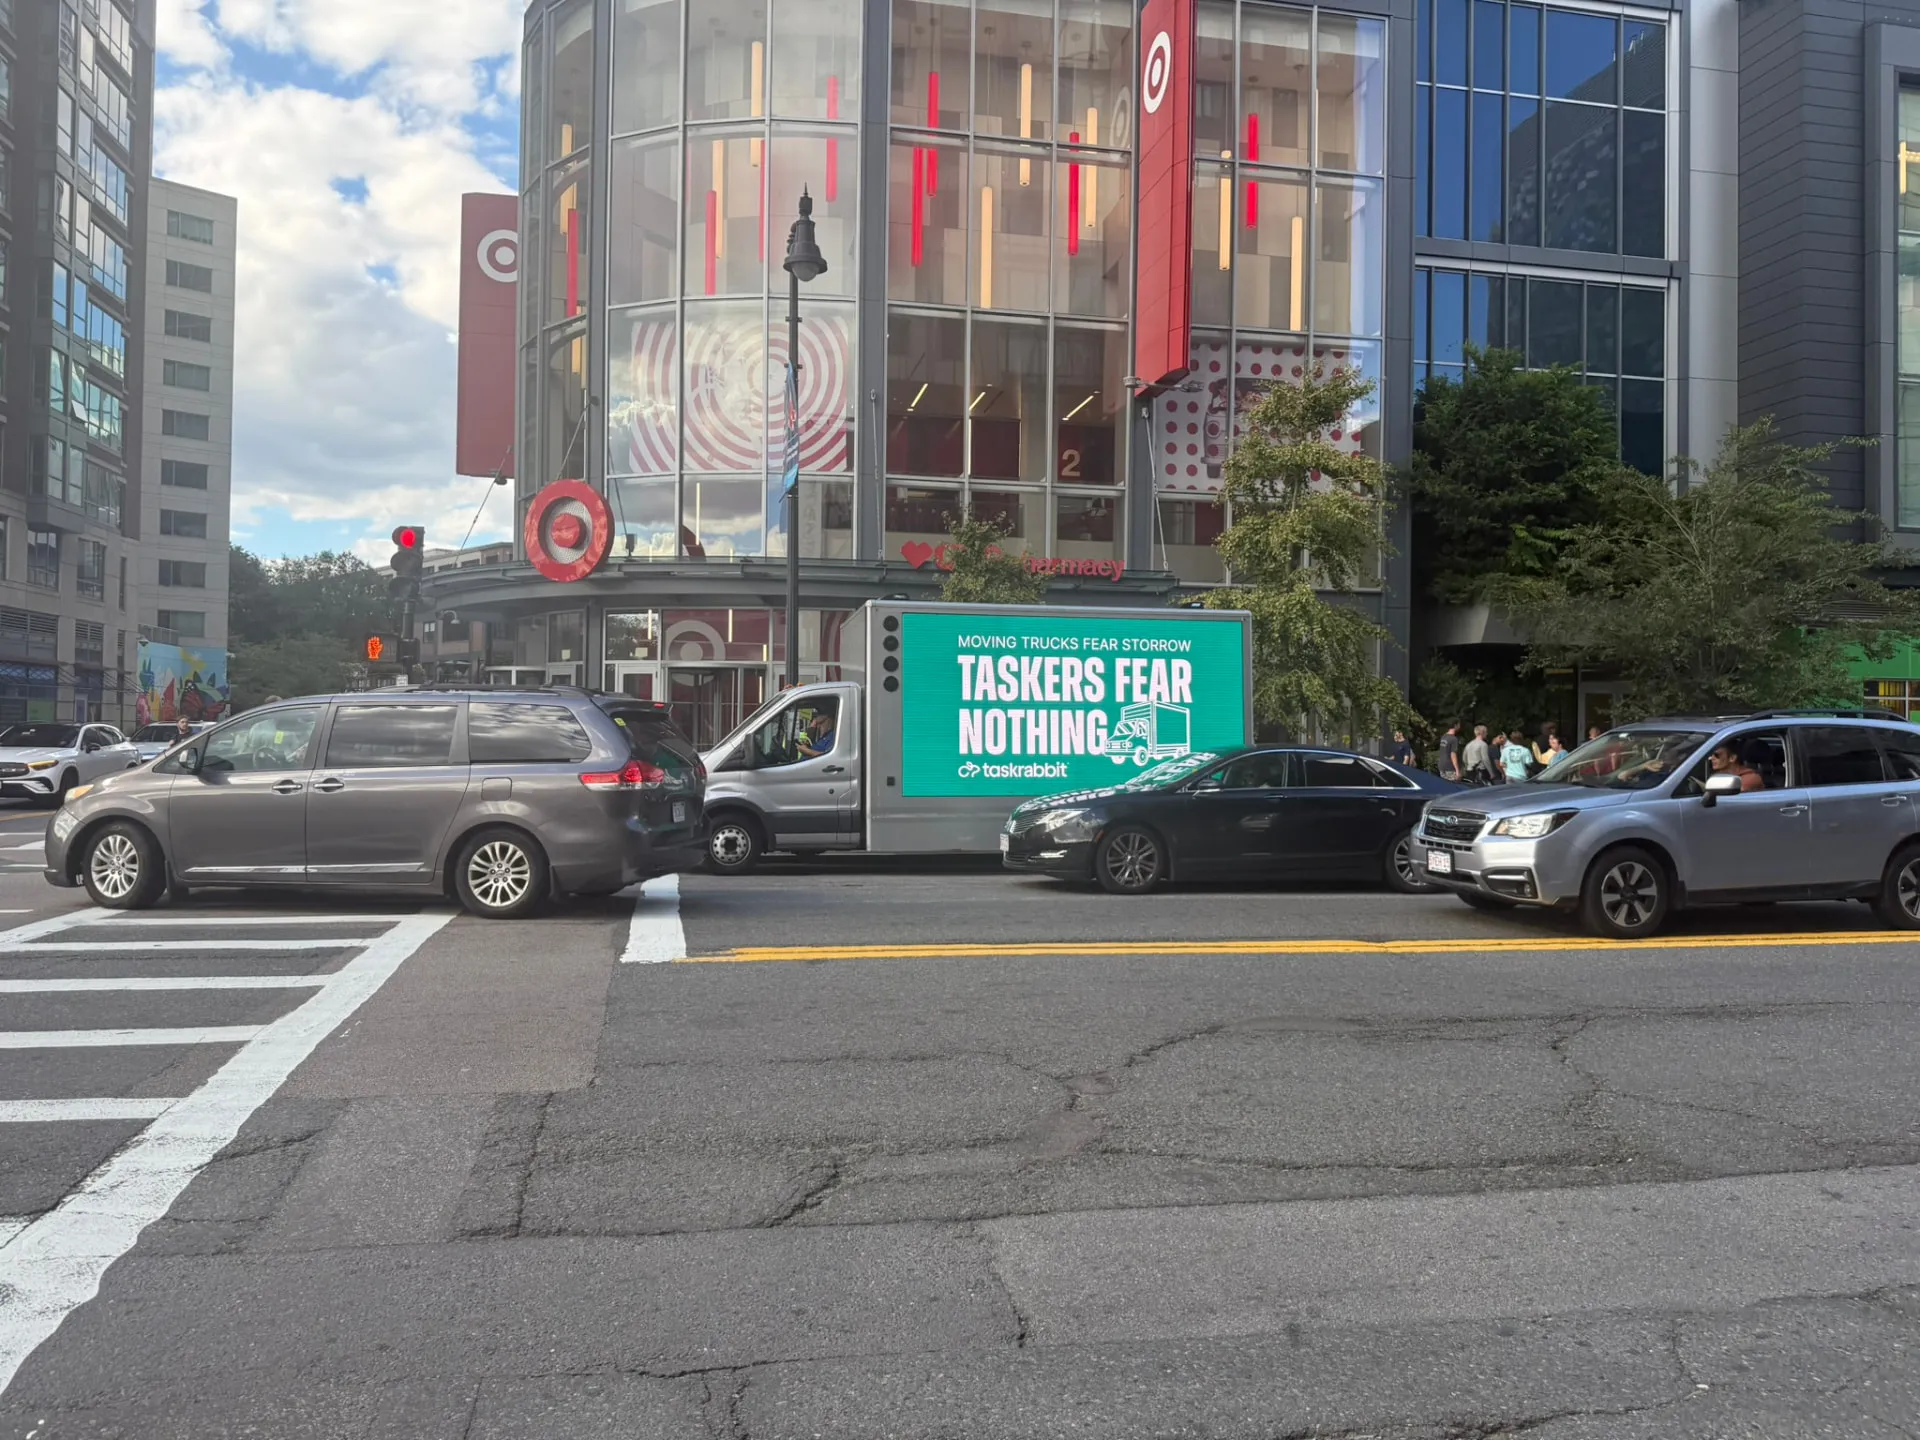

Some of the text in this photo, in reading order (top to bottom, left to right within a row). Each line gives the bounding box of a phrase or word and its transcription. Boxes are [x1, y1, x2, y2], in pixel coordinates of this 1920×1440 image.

[1062, 449, 1081, 476] 2
[958, 635, 1192, 652] MOVING TRUCKS FEAR STORROW
[957, 655, 1193, 703] TASKERS FEAR
[959, 708, 1109, 756] NOTHING
[982, 762, 1068, 778] taskrabbit
